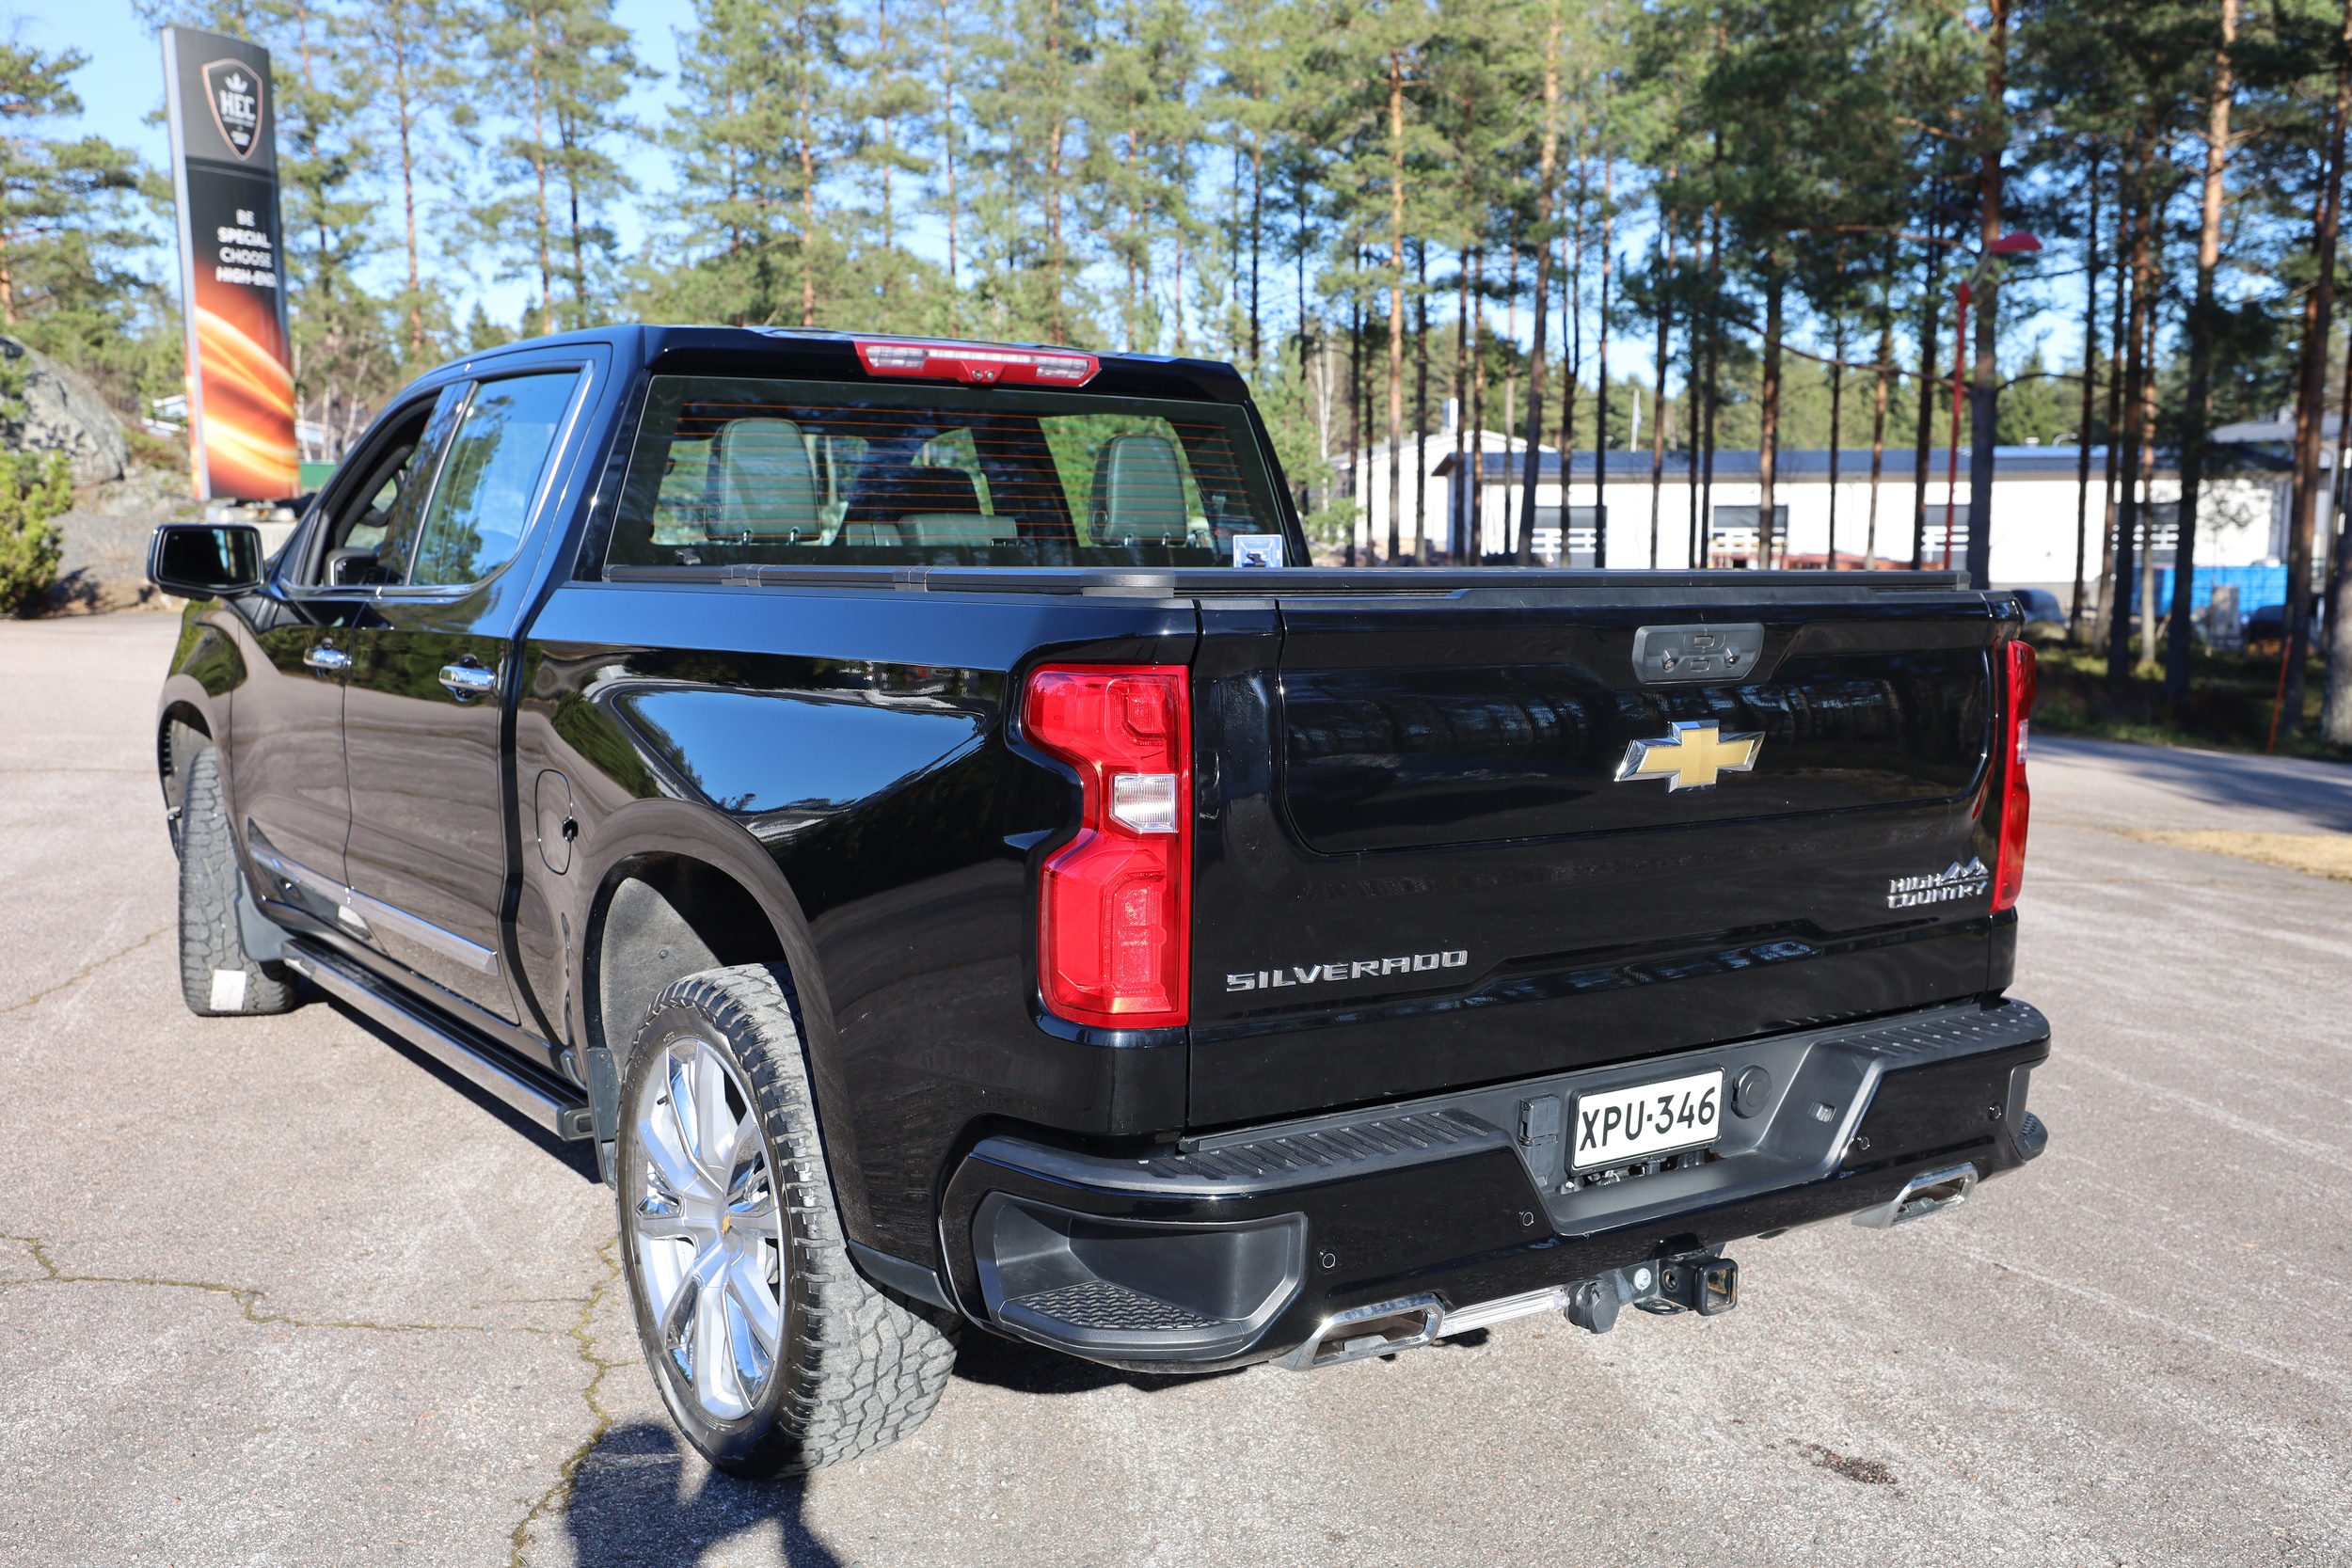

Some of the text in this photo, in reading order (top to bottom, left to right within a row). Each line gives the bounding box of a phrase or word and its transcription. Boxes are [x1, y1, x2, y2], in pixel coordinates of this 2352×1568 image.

[218, 89, 256, 121] HEC
[235, 209, 255, 227] BE
[219, 246, 273, 268] CHOOSE
[1887, 881, 1987, 909] COUNTRY
[1889, 873, 1942, 894] HIGH
[1226, 949, 1468, 991] SILVERADO
[1579, 1086, 1715, 1151] XPU-346
